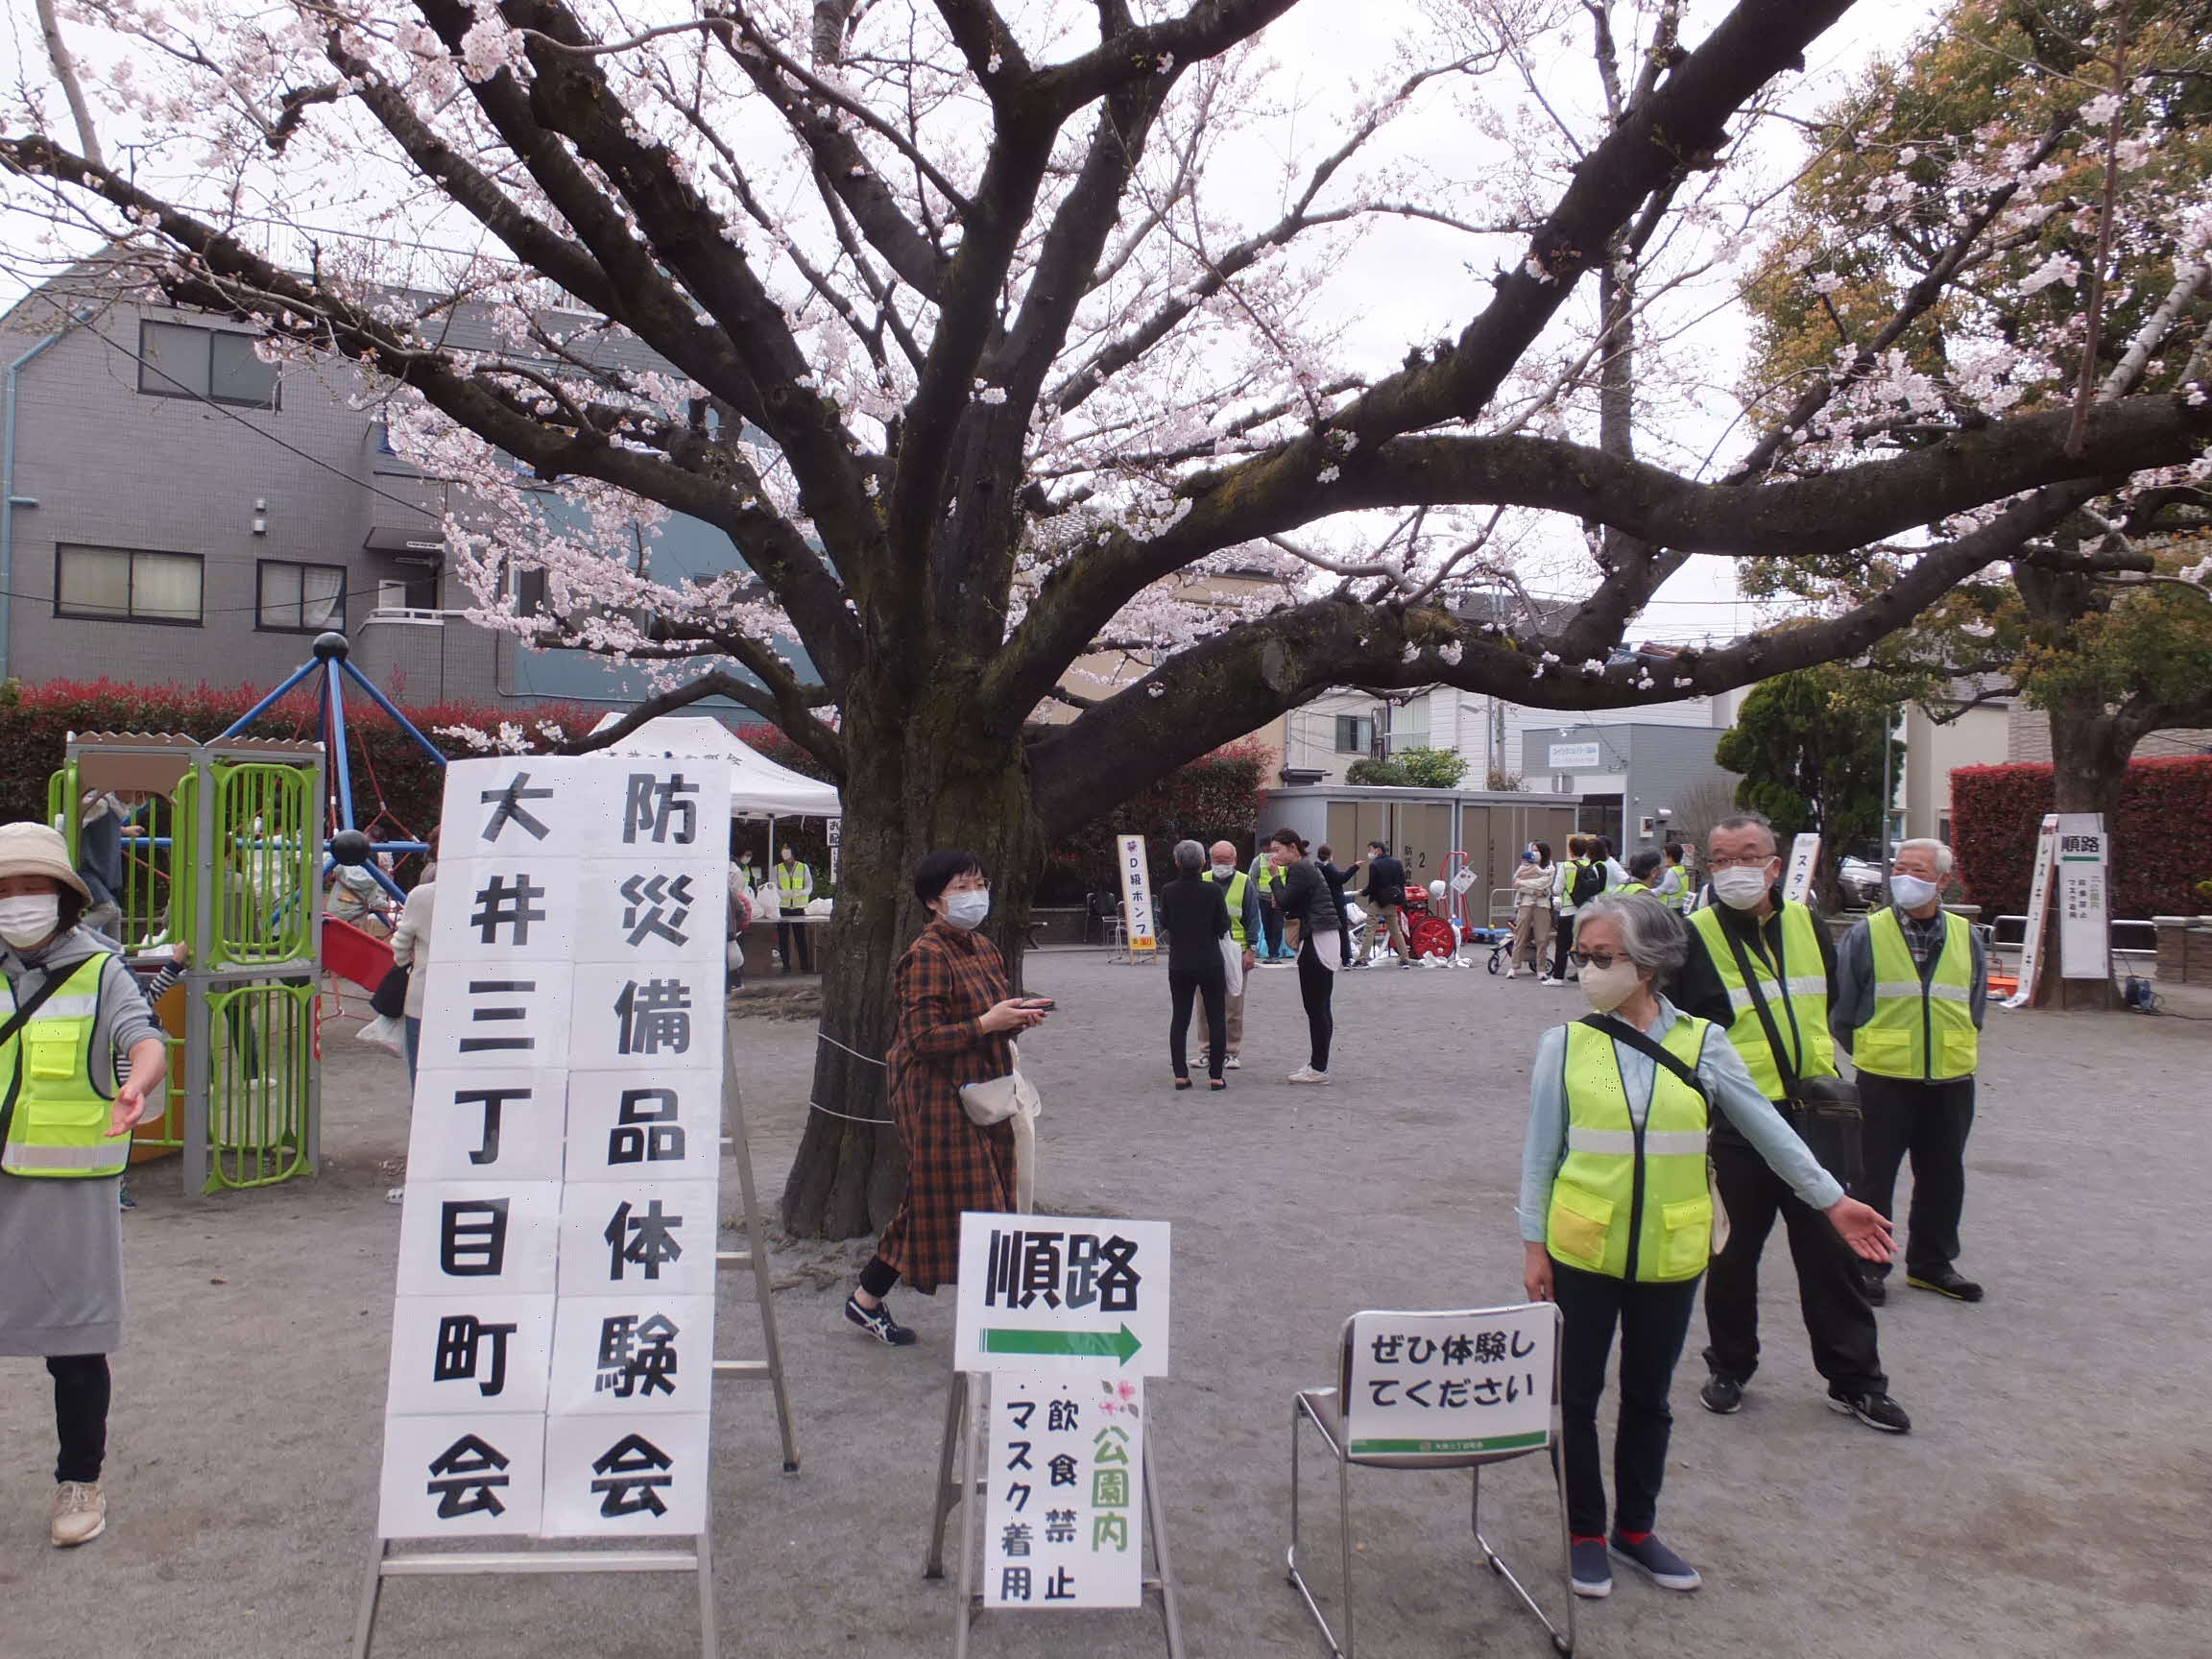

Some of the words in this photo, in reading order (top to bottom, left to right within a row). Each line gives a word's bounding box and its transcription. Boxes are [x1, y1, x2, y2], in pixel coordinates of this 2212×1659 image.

[1418, 852, 1426, 868] 2
[2061, 836, 2100, 853] 順路
[427, 772, 554, 1519] 大井三丁目町会
[590, 773, 701, 1519] 防災備品体験会
[985, 1229, 1142, 1312] 順路
[1371, 1330, 1535, 1366] ぜひ体験し
[1368, 1373, 1533, 1408] てください
[1092, 1425, 1129, 1552] 公園内
